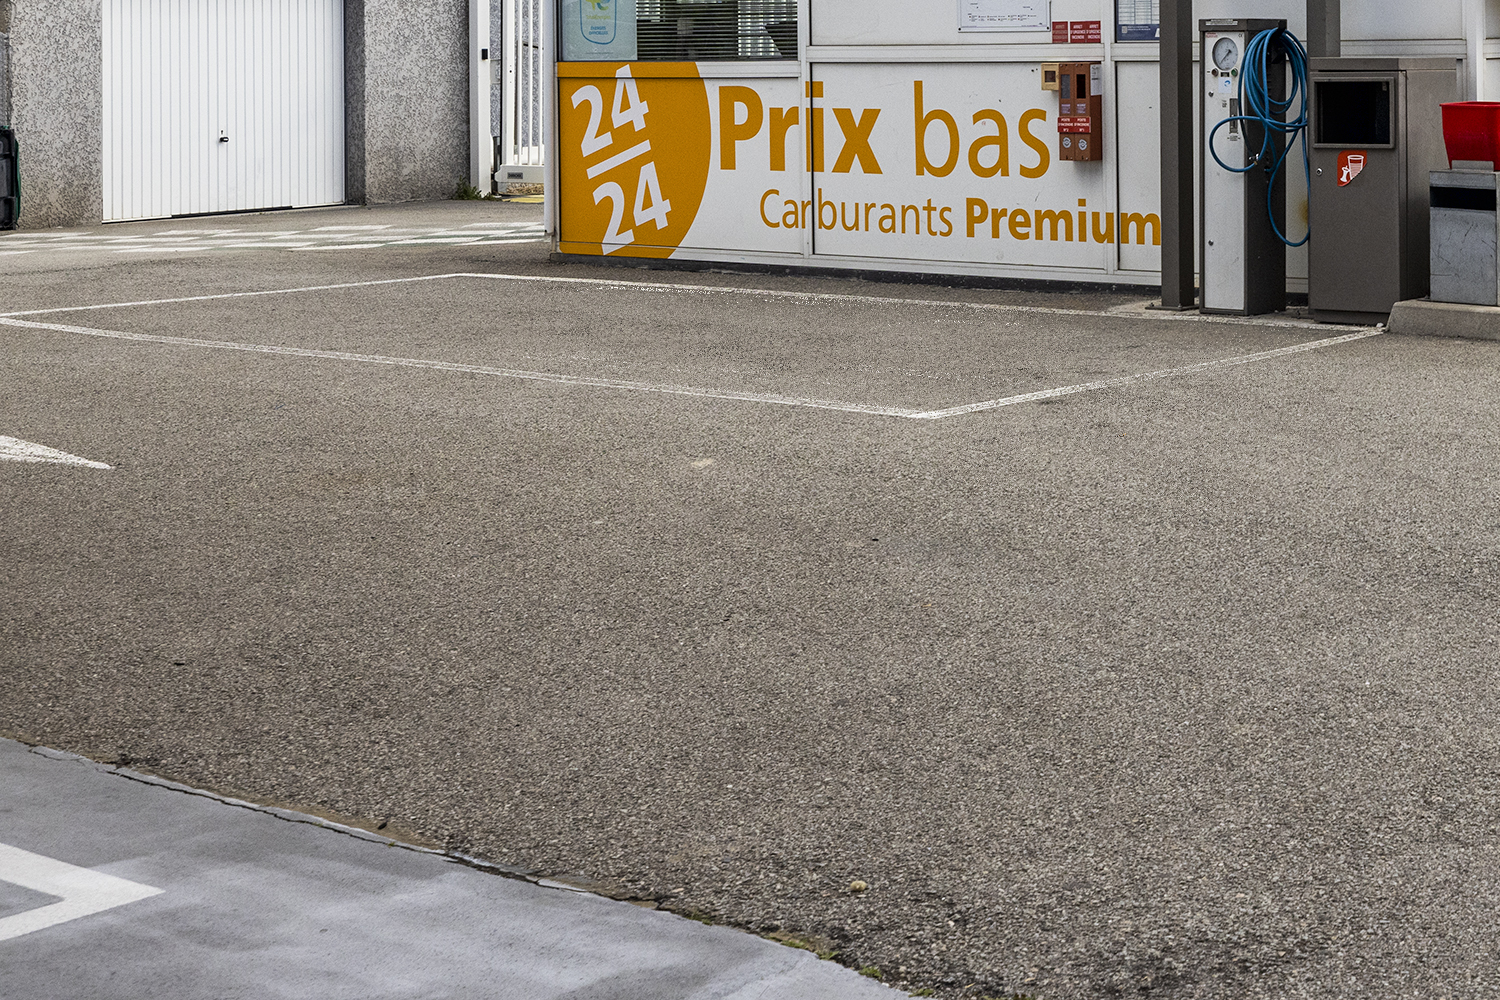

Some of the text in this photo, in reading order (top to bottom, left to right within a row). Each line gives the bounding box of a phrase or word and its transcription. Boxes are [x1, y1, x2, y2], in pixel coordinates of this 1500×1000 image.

[571, 64, 650, 158] 24
[718, 80, 1051, 179] Prix bas
[592, 160, 672, 256] 24
[759, 187, 1161, 246] Carburants Premium
